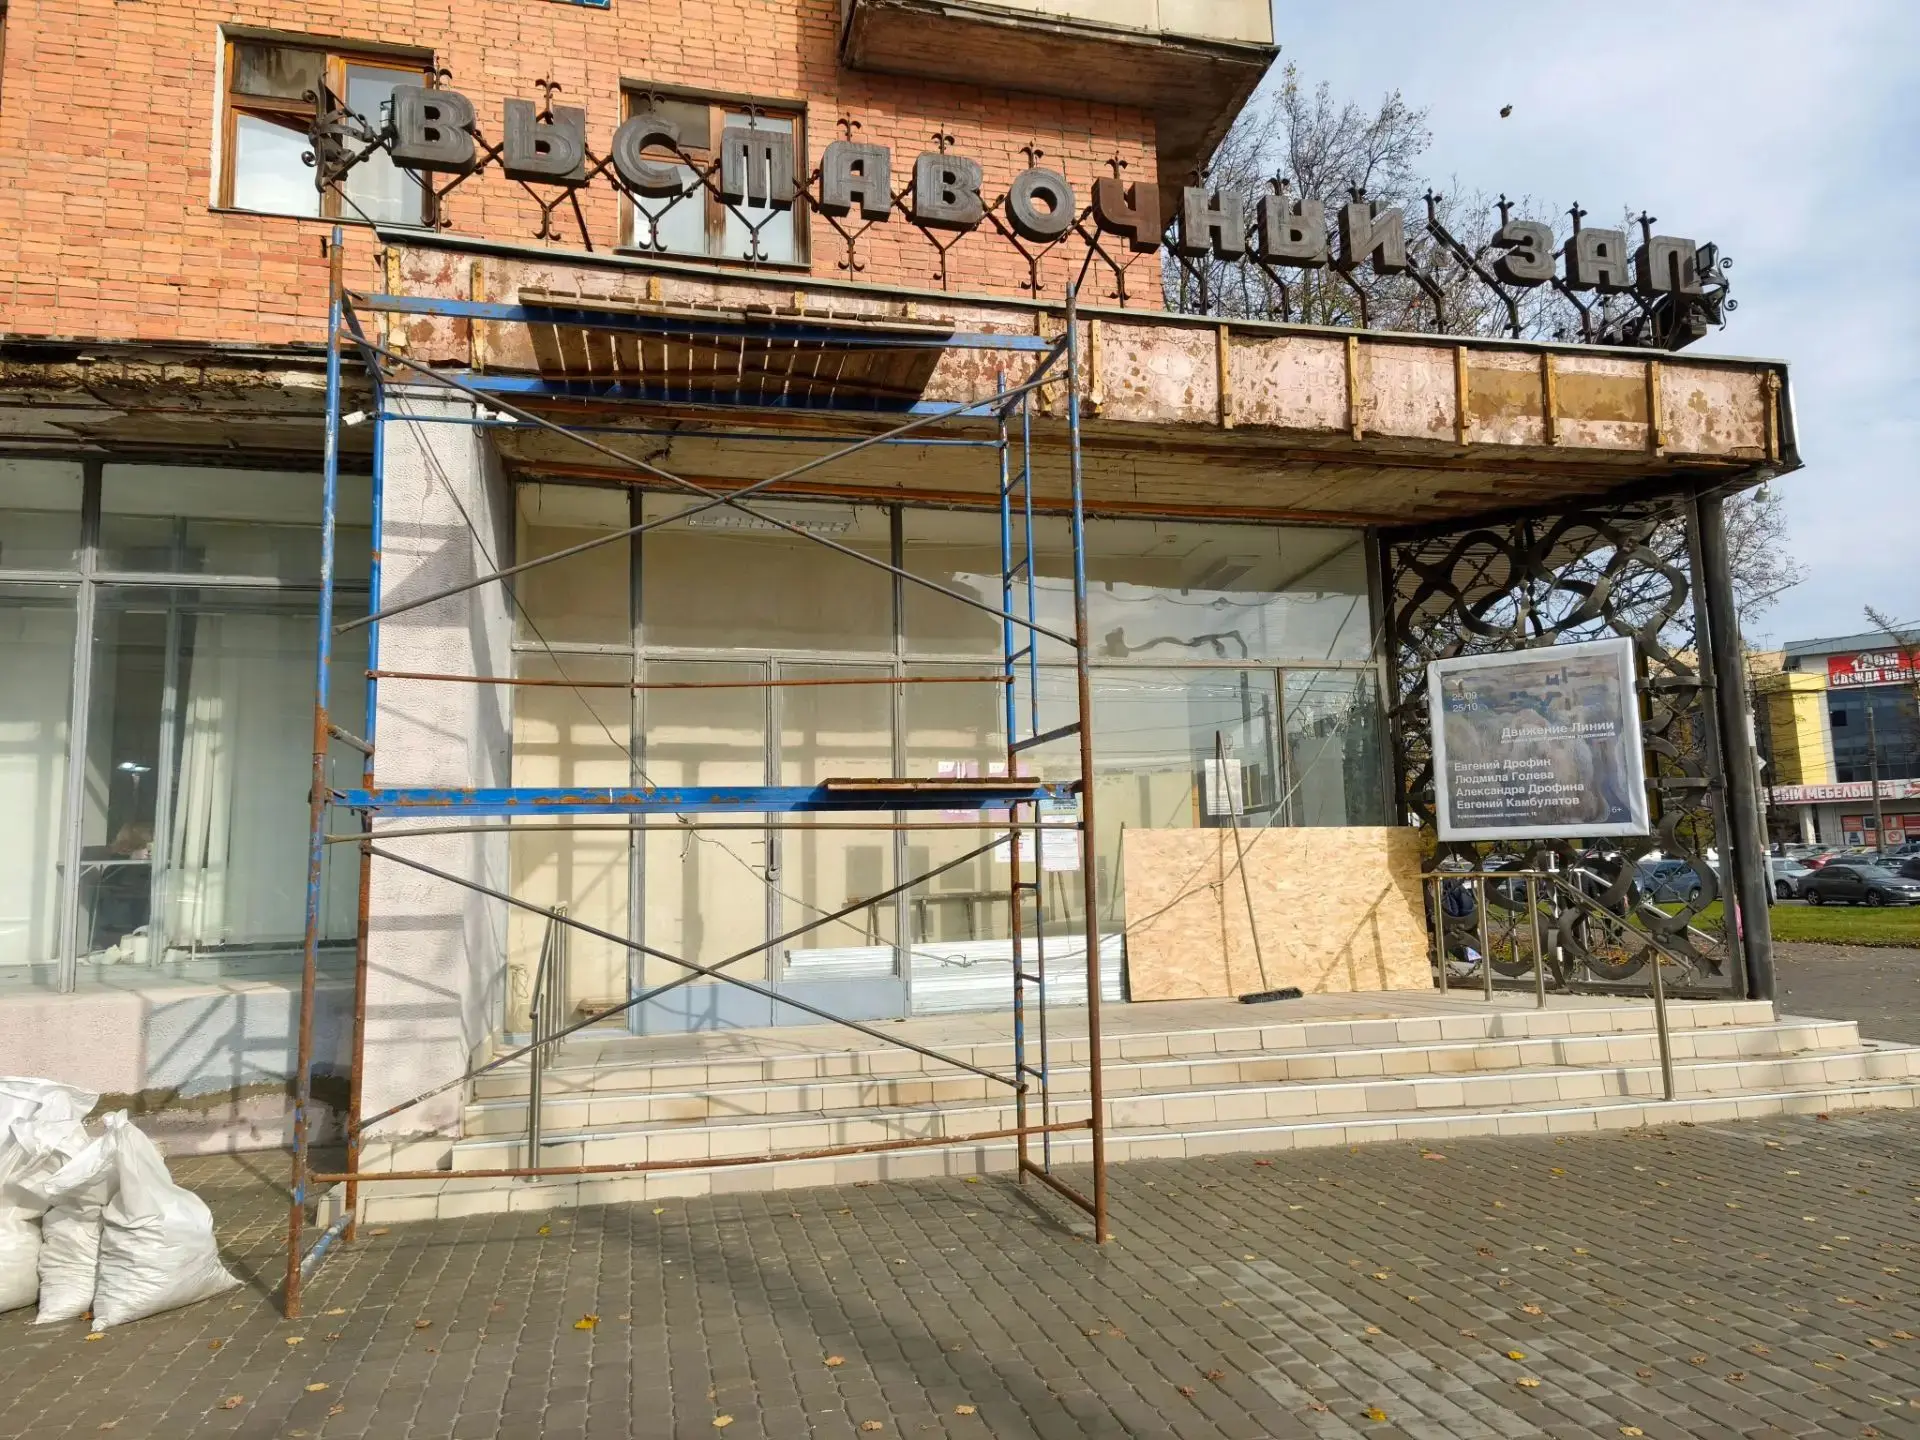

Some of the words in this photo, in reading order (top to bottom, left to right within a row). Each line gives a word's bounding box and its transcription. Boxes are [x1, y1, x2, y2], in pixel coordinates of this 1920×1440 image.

[1492, 219, 1704, 298] ЗАЛ
[1452, 702, 1478, 712] 25/10
[1501, 724, 1568, 739] Движение
[1571, 721, 1615, 733] Линии
[1454, 761, 1500, 772] Евгений
[1503, 758, 1551, 770] Дрофин
[1455, 774, 1509, 784] Людмила
[1511, 771, 1554, 781] Голева
[1456, 786, 1525, 797] Александра
[1528, 782, 1585, 795] Дрофина
[1456, 799, 1503, 810] Евгений
[1506, 796, 1580, 808] Камбулатов
